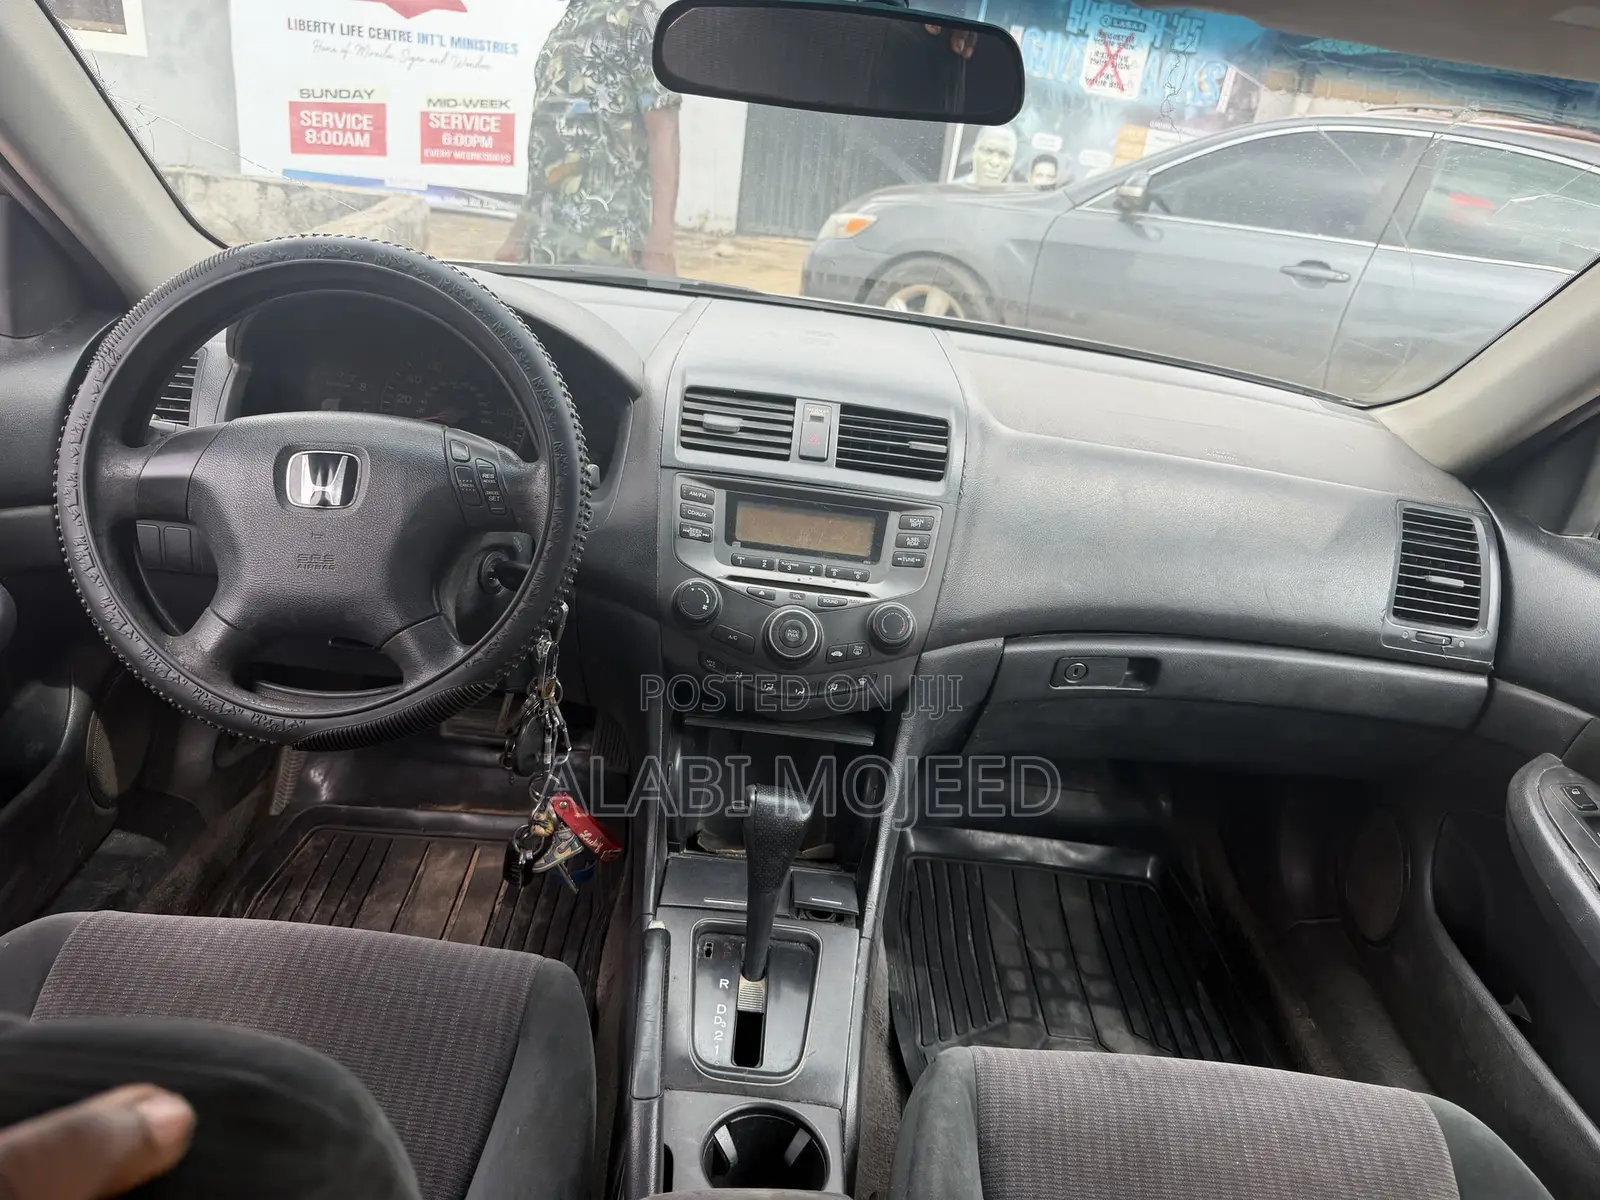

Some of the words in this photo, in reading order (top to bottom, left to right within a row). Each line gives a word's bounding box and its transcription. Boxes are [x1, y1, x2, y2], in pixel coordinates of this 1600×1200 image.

[287, 17, 336, 35] LIBERTY
[340, 23, 365, 38] LIFE
[368, 27, 413, 43] CENTRE
[417, 32, 447, 48] INT'L
[450, 35, 519, 56] MINISTRIES
[299, 88, 375, 100] SUNDAY
[426, 98, 512, 109] MID-WEEK
[300, 110, 374, 131] SERVICE
[428, 113, 501, 133] SERVICE
[305, 128, 370, 148] 8:00AM
[441, 133, 493, 149] 6:00PM
[396, 392, 412, 405] 20
[688, 490, 707, 499] AM/FM
[822, 597, 839, 605] SOUND
[727, 634, 738, 642] A/C
[719, 978, 730, 989] R
[716, 1003, 727, 1014] D
[713, 1029, 724, 1041] 2
[715, 1044, 719, 1055] 1
